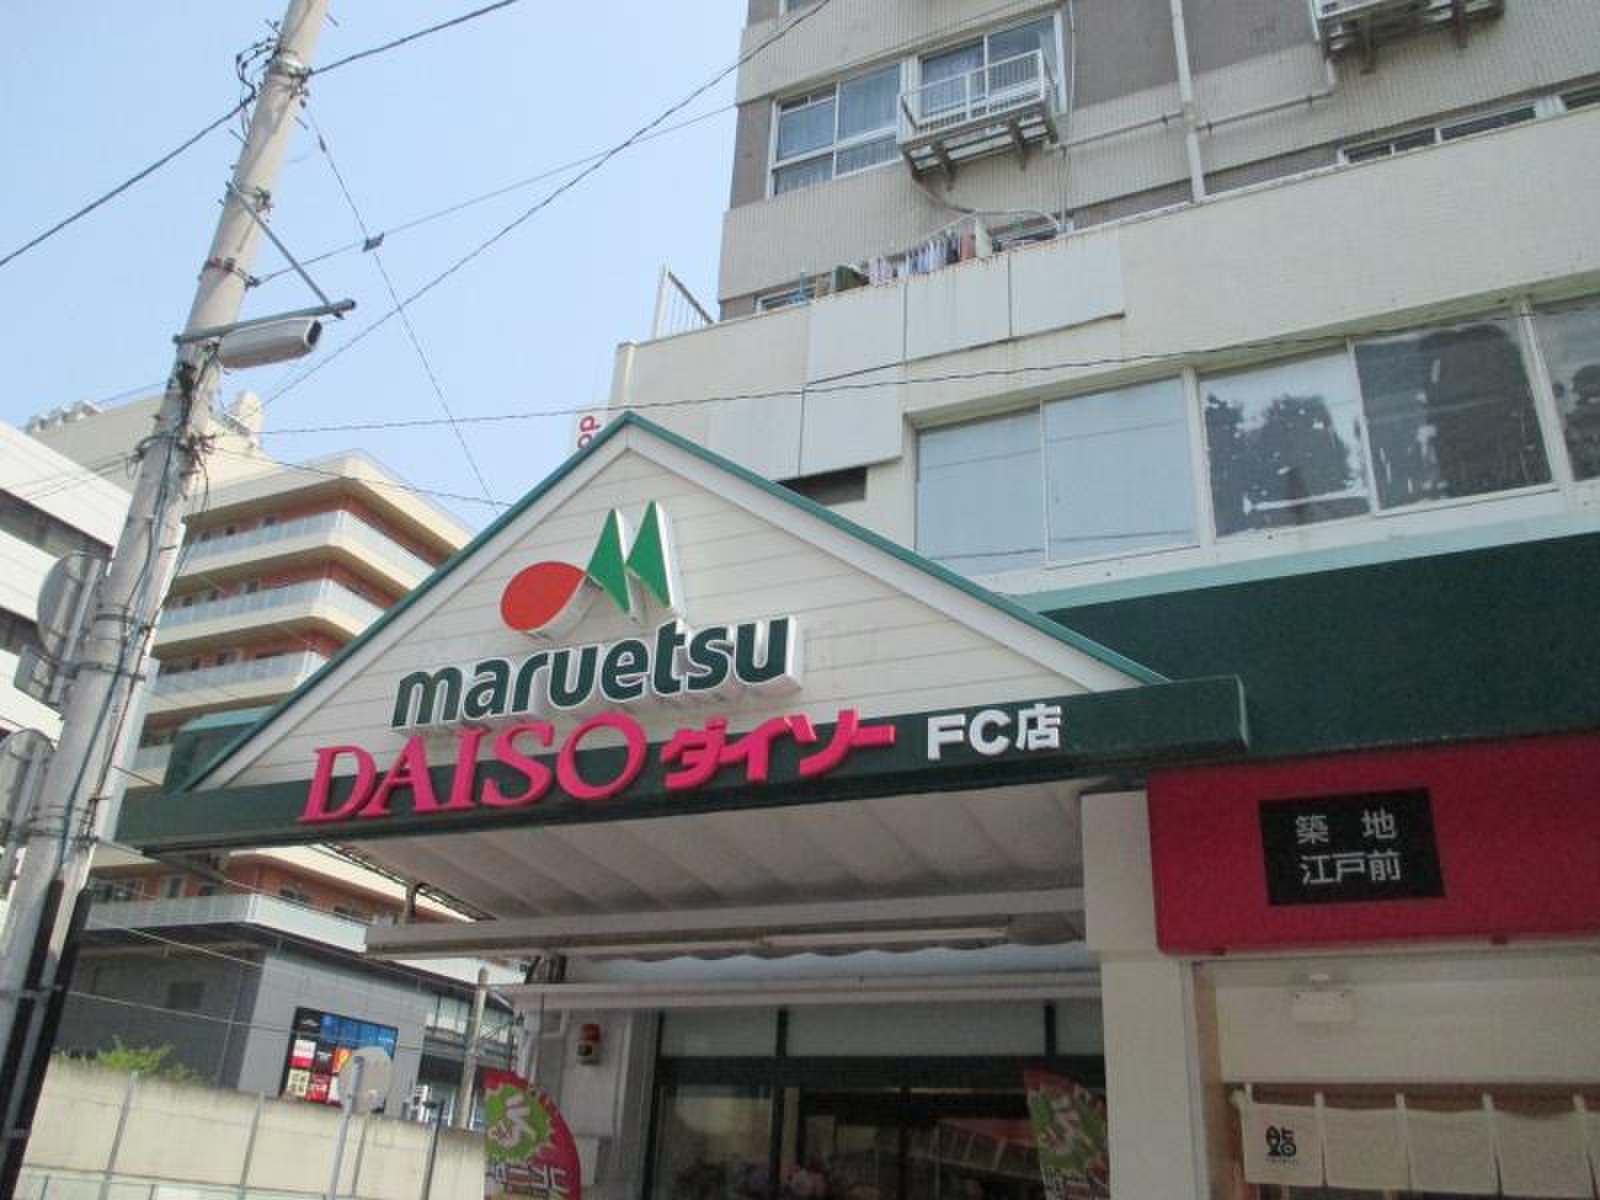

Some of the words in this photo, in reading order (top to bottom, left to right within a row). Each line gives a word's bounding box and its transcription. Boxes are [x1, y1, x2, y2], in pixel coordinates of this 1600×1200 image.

[393, 615, 792, 728] maruetsu
[299, 712, 647, 823] DAISO
[660, 709, 896, 790] ダイソー
[926, 703, 1063, 760] FC店
[1300, 849, 1402, 885] 江戸前
